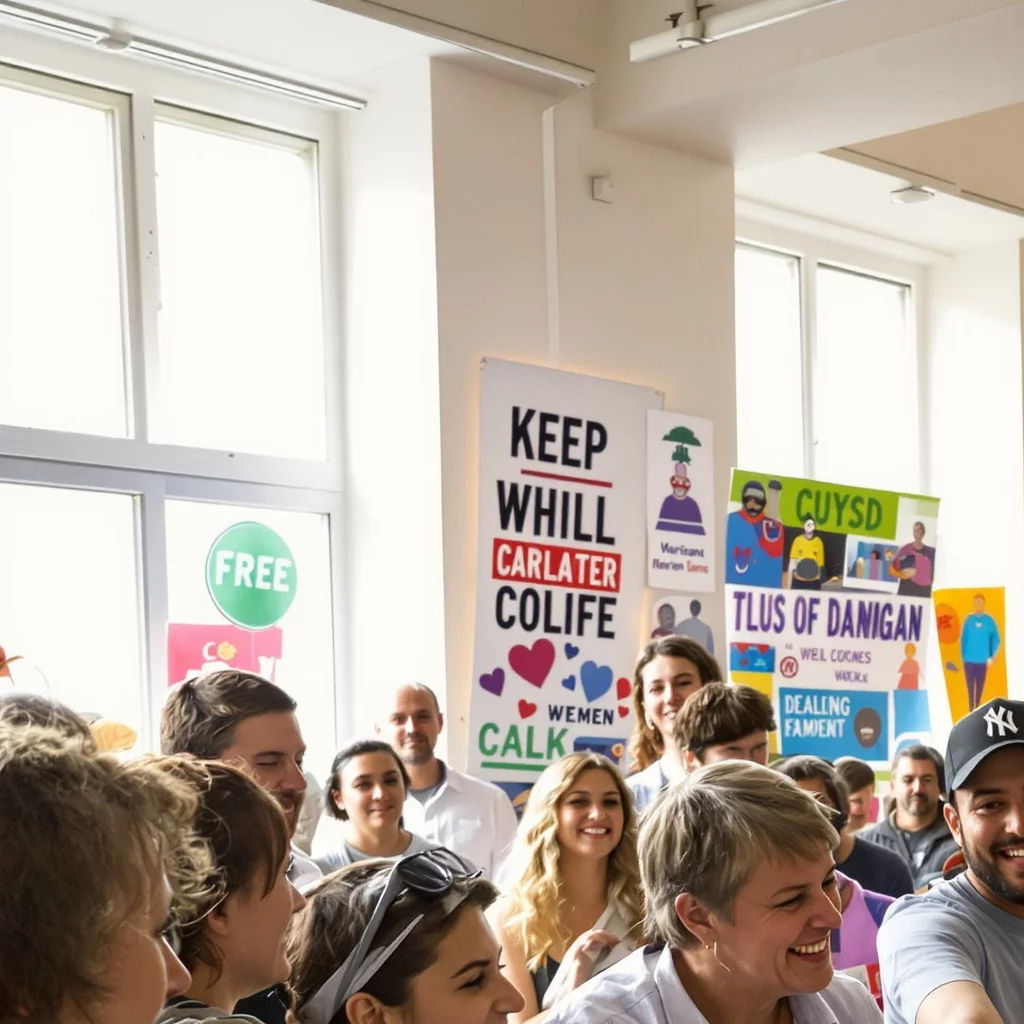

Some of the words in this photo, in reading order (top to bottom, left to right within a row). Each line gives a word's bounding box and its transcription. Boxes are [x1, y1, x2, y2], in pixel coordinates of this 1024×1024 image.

[510, 405, 608, 470] KEEP
[496, 479, 616, 546] WHILL
[795, 488, 884, 531] CUYSD
[215, 550, 292, 593] FREE
[497, 543, 619, 589] CARLATER
[495, 585, 618, 640] COLIFE
[733, 591, 786, 634] TLUS
[793, 596, 821, 636] OF
[827, 599, 923, 642] DANIGAN
[548, 704, 615, 726] WEMEN
[785, 694, 851, 717] DEALING
[478, 722, 569, 760] CALK
